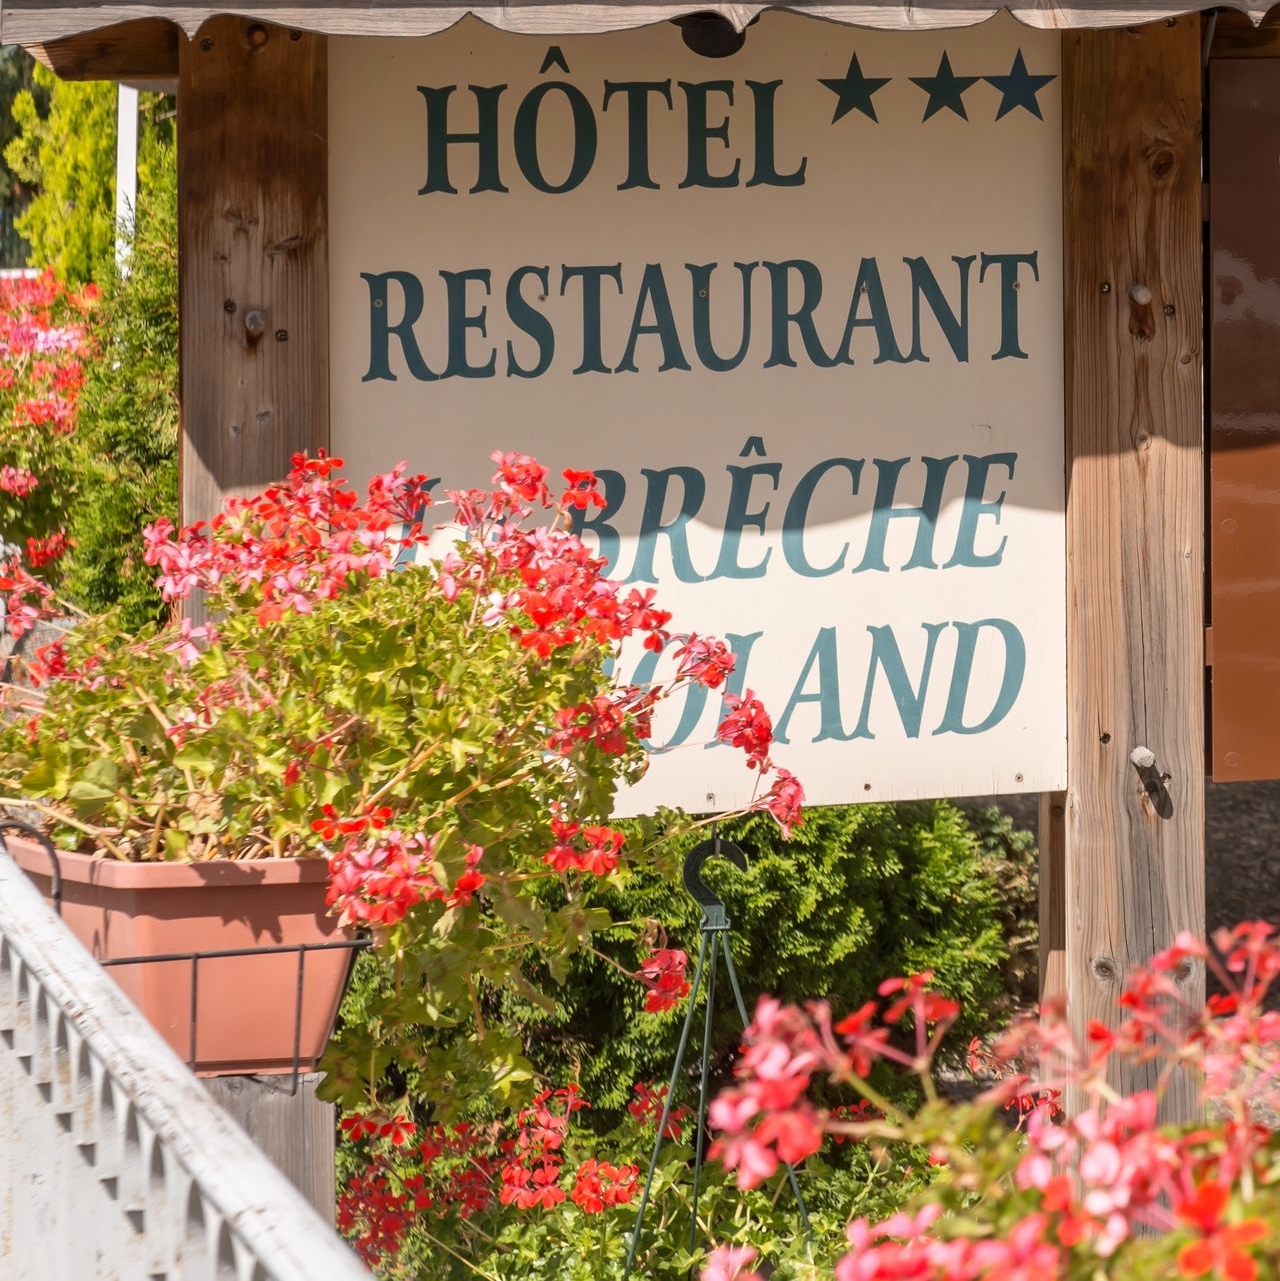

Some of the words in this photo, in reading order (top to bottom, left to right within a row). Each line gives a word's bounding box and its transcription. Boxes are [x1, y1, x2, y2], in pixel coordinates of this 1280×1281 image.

[416, 45, 808, 196] HÔTEL
[360, 250, 1041, 383] RESTAURANT
[562, 436, 1019, 585] BRÊCHE
[545, 619, 1027, 757] OLAND
